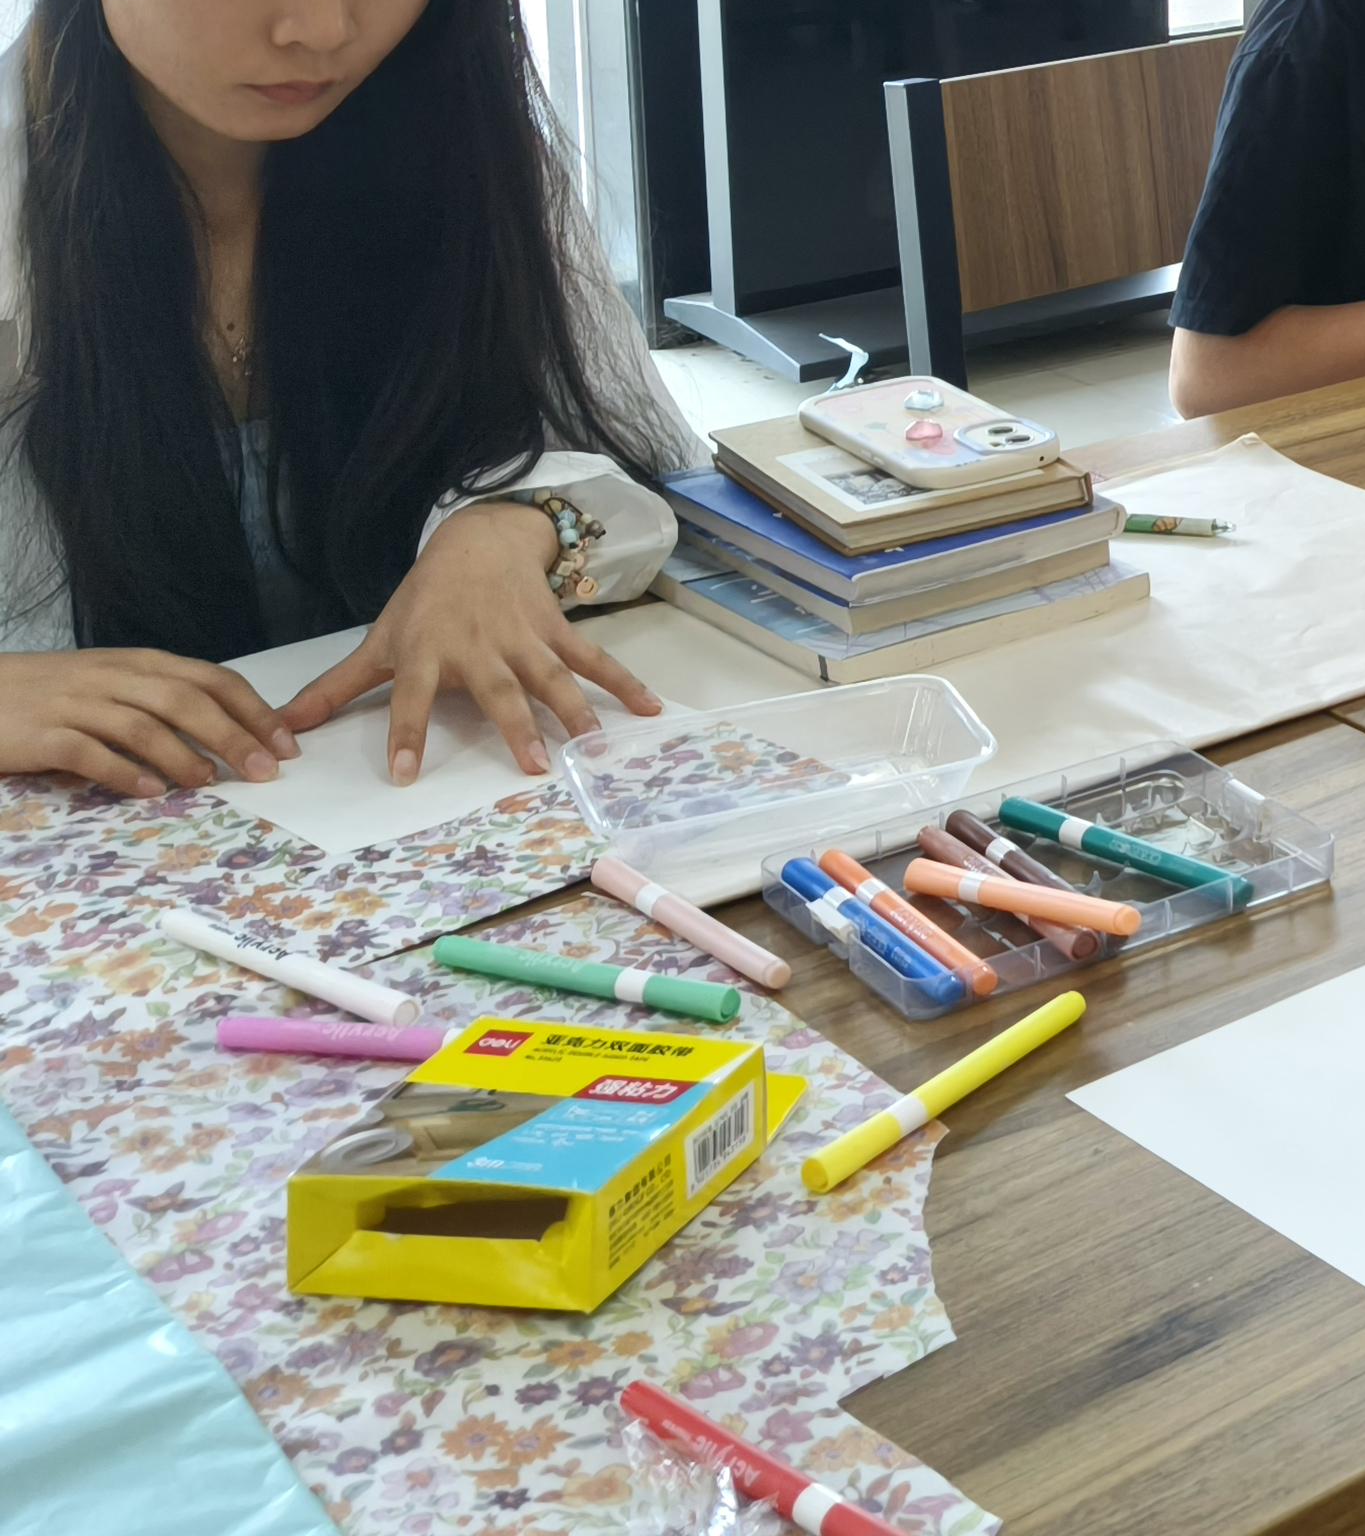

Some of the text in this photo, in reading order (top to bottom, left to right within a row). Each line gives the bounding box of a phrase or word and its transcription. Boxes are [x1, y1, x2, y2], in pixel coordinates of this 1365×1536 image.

[232, 931, 292, 961] Acrylic
[322, 1023, 402, 1043] Acrylic
[540, 1034, 694, 1057] 亚克力双面胶带
[589, 1079, 679, 1099] 强粘力
[694, 1432, 762, 1488] Acrylic
